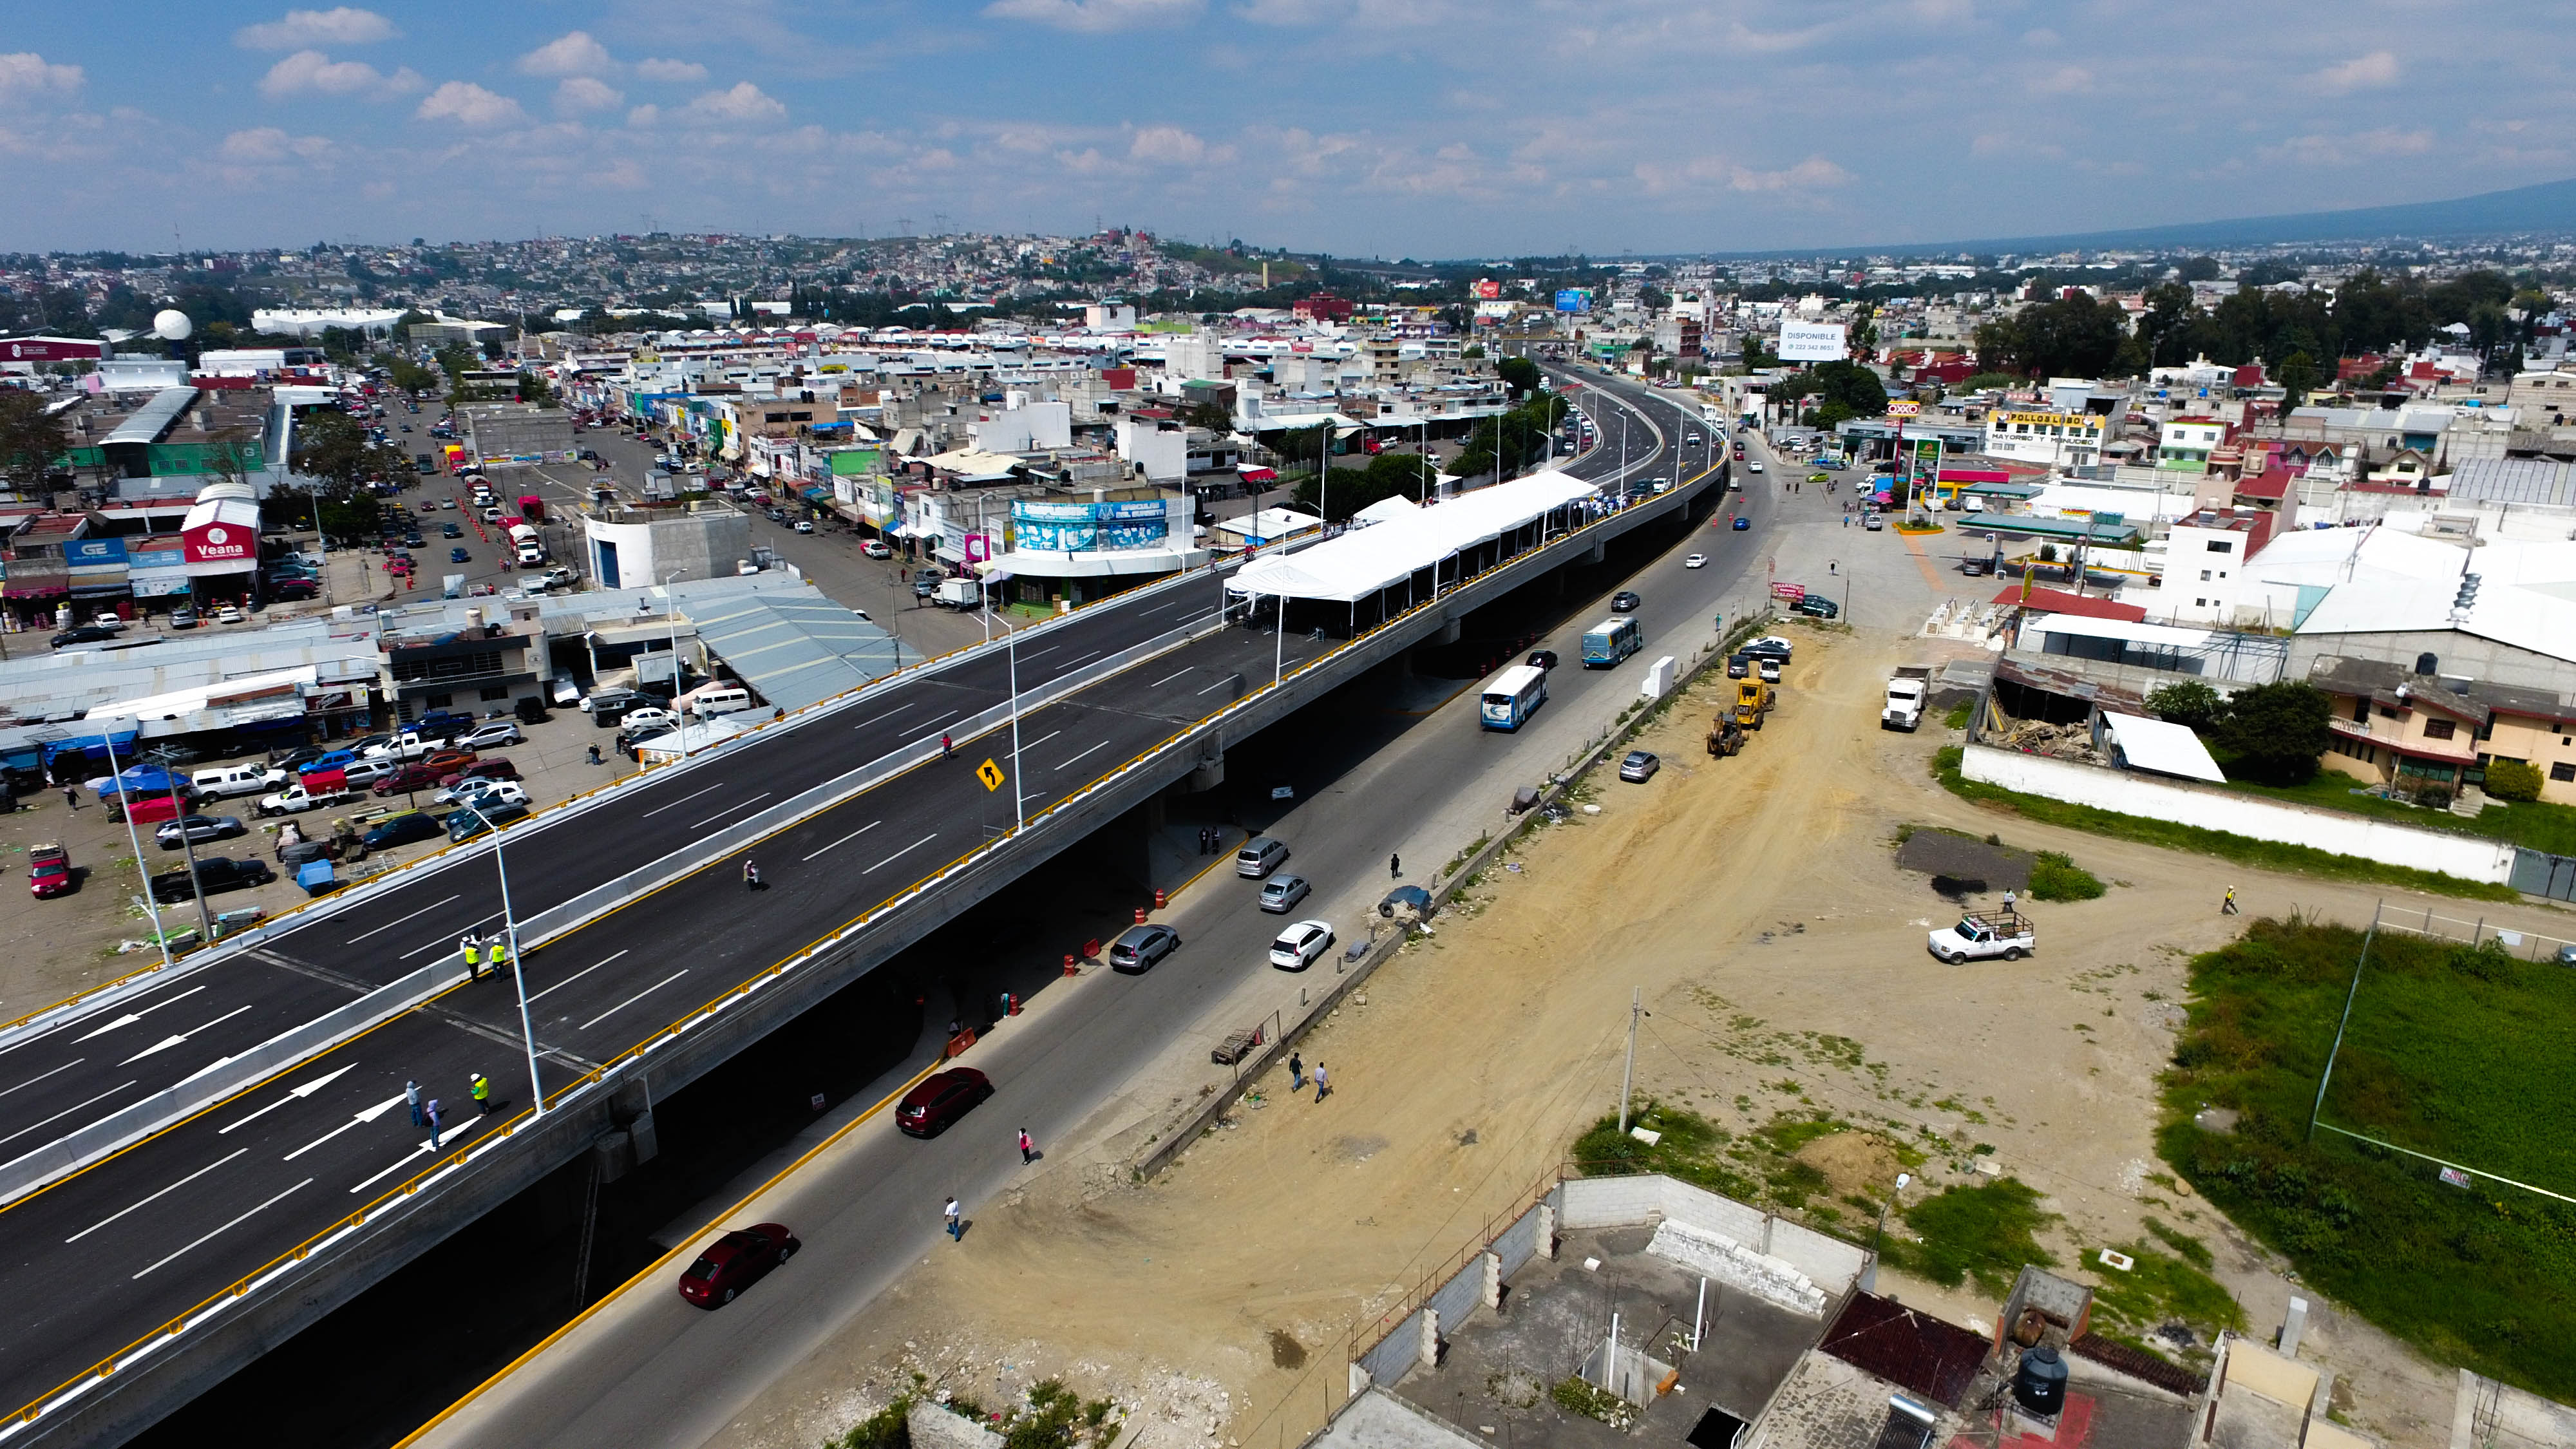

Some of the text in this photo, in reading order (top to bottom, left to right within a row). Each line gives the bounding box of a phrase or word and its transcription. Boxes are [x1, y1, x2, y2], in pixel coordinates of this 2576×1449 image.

[1888, 404, 1918, 413] OXXO
[2011, 413, 2050, 422] POLLOS
[81, 543, 108, 555] GE
[196, 544, 243, 555] Veana
